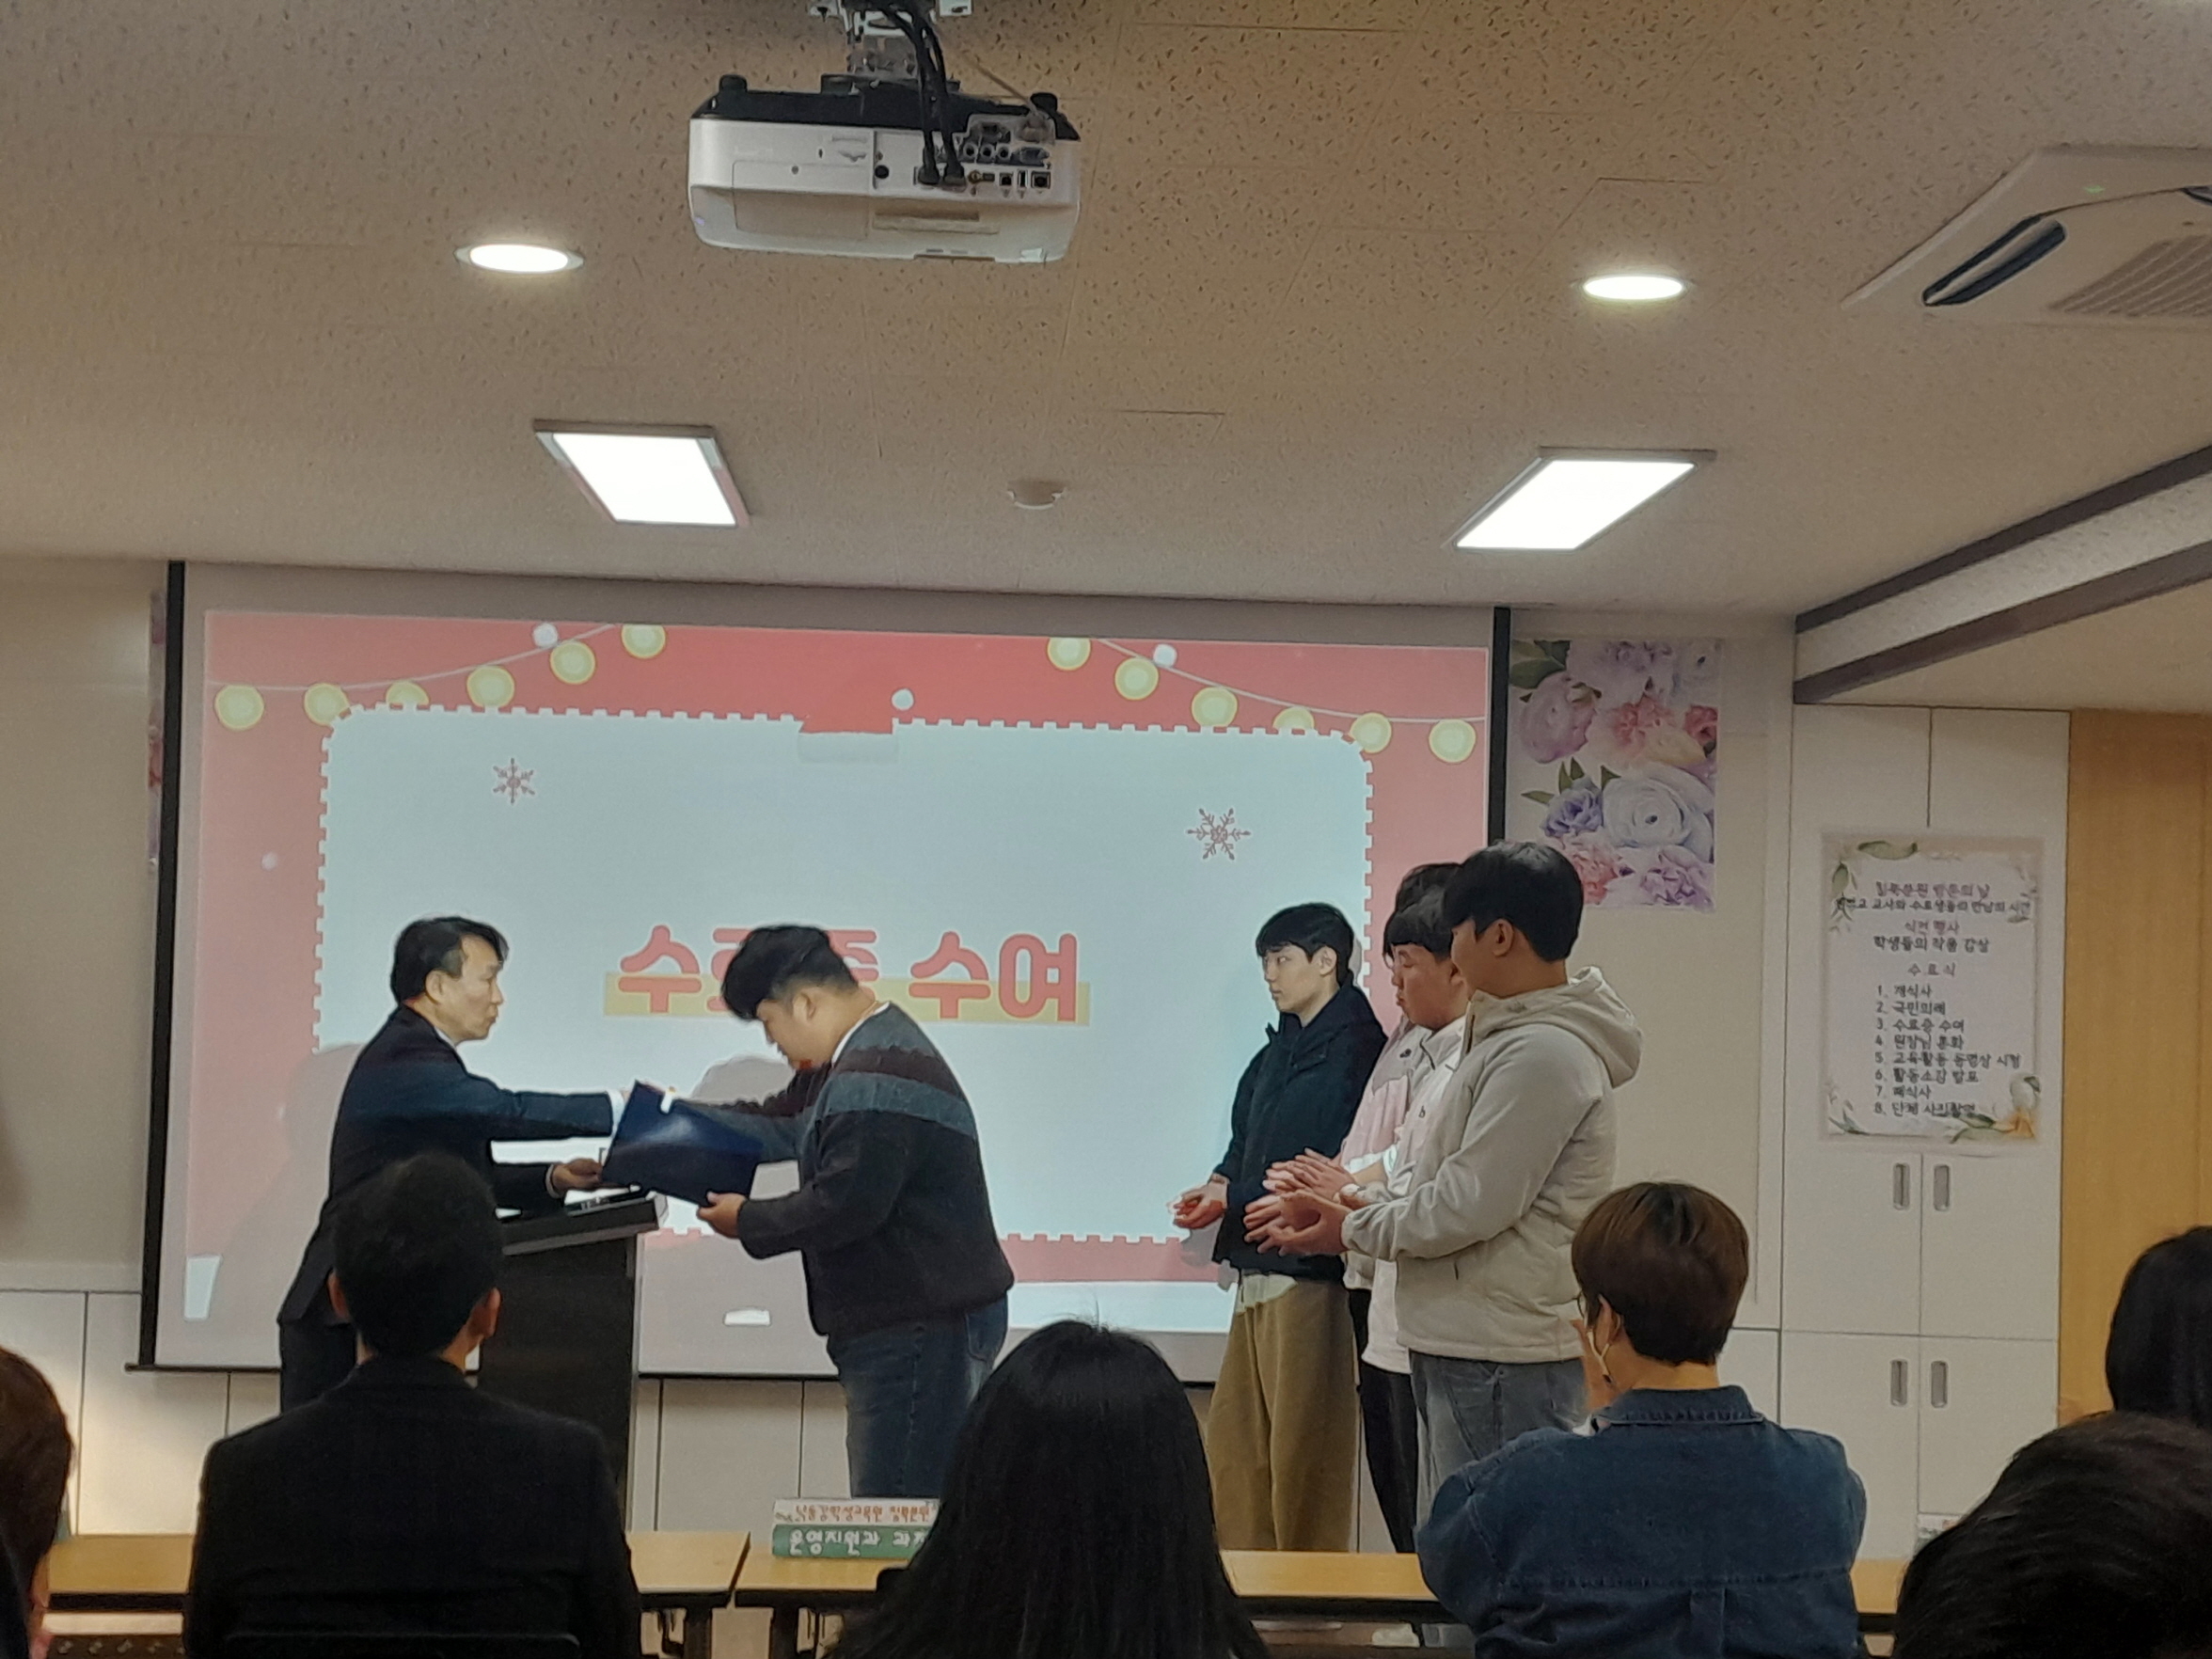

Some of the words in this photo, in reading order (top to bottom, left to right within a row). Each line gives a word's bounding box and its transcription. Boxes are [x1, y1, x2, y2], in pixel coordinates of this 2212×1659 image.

[1873, 936, 1928, 952] 학생들의
[908, 931, 1078, 1022] 수여
[1892, 1001, 1946, 1017] 국민의례
[1892, 1018, 1935, 1034] 수료증
[1939, 1019, 1965, 1034] 수여
[1893, 1051, 1949, 1067] 교육활동
[1892, 1067, 1947, 1084] 활동소감
[789, 1528, 880, 1556] 운영지원과
